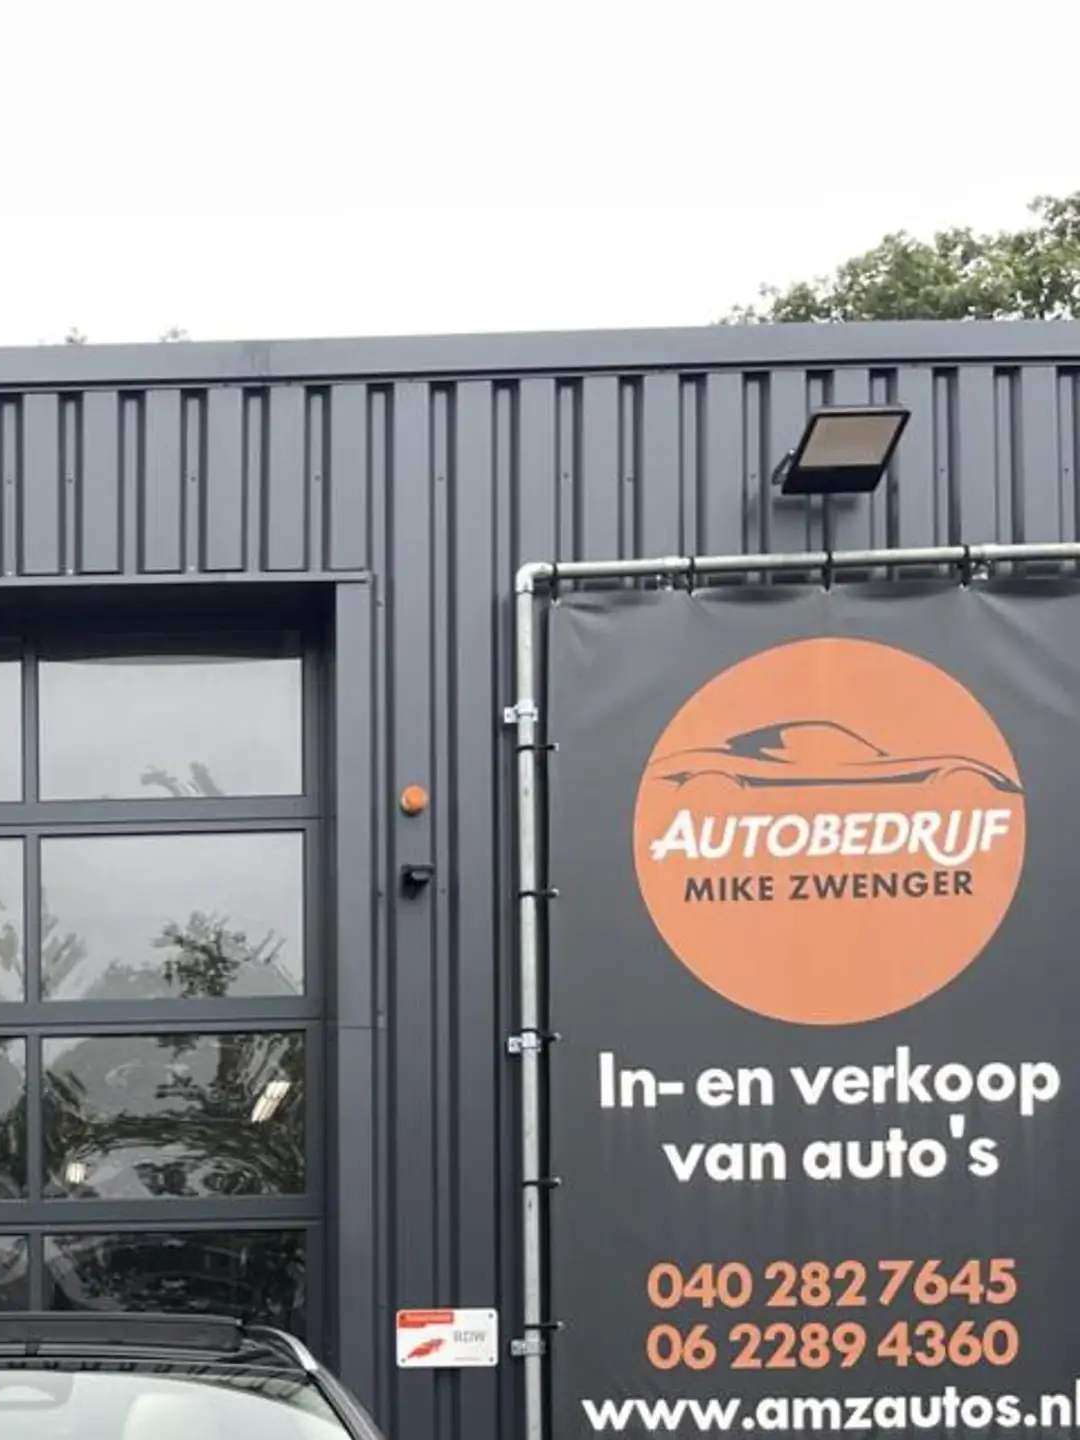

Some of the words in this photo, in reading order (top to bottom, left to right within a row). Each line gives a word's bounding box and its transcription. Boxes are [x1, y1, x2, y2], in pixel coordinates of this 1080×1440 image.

[649, 809, 1012, 867] AUTOBEDRIJF
[683, 876, 774, 902] MIKE
[789, 870, 973, 900] ZWENGER
[599, 1052, 685, 1108] In-
[696, 1066, 774, 1107] en
[790, 1046, 1061, 1116] verkoop
[663, 1142, 787, 1182] van
[802, 1114, 1000, 1181] auto's
[647, 1261, 753, 1308] 040
[764, 1260, 867, 1307] 282
[877, 1258, 1018, 1305] 7645
[646, 1323, 717, 1370] 06
[728, 1322, 867, 1370] 2289
[876, 1320, 1019, 1367] 4360
